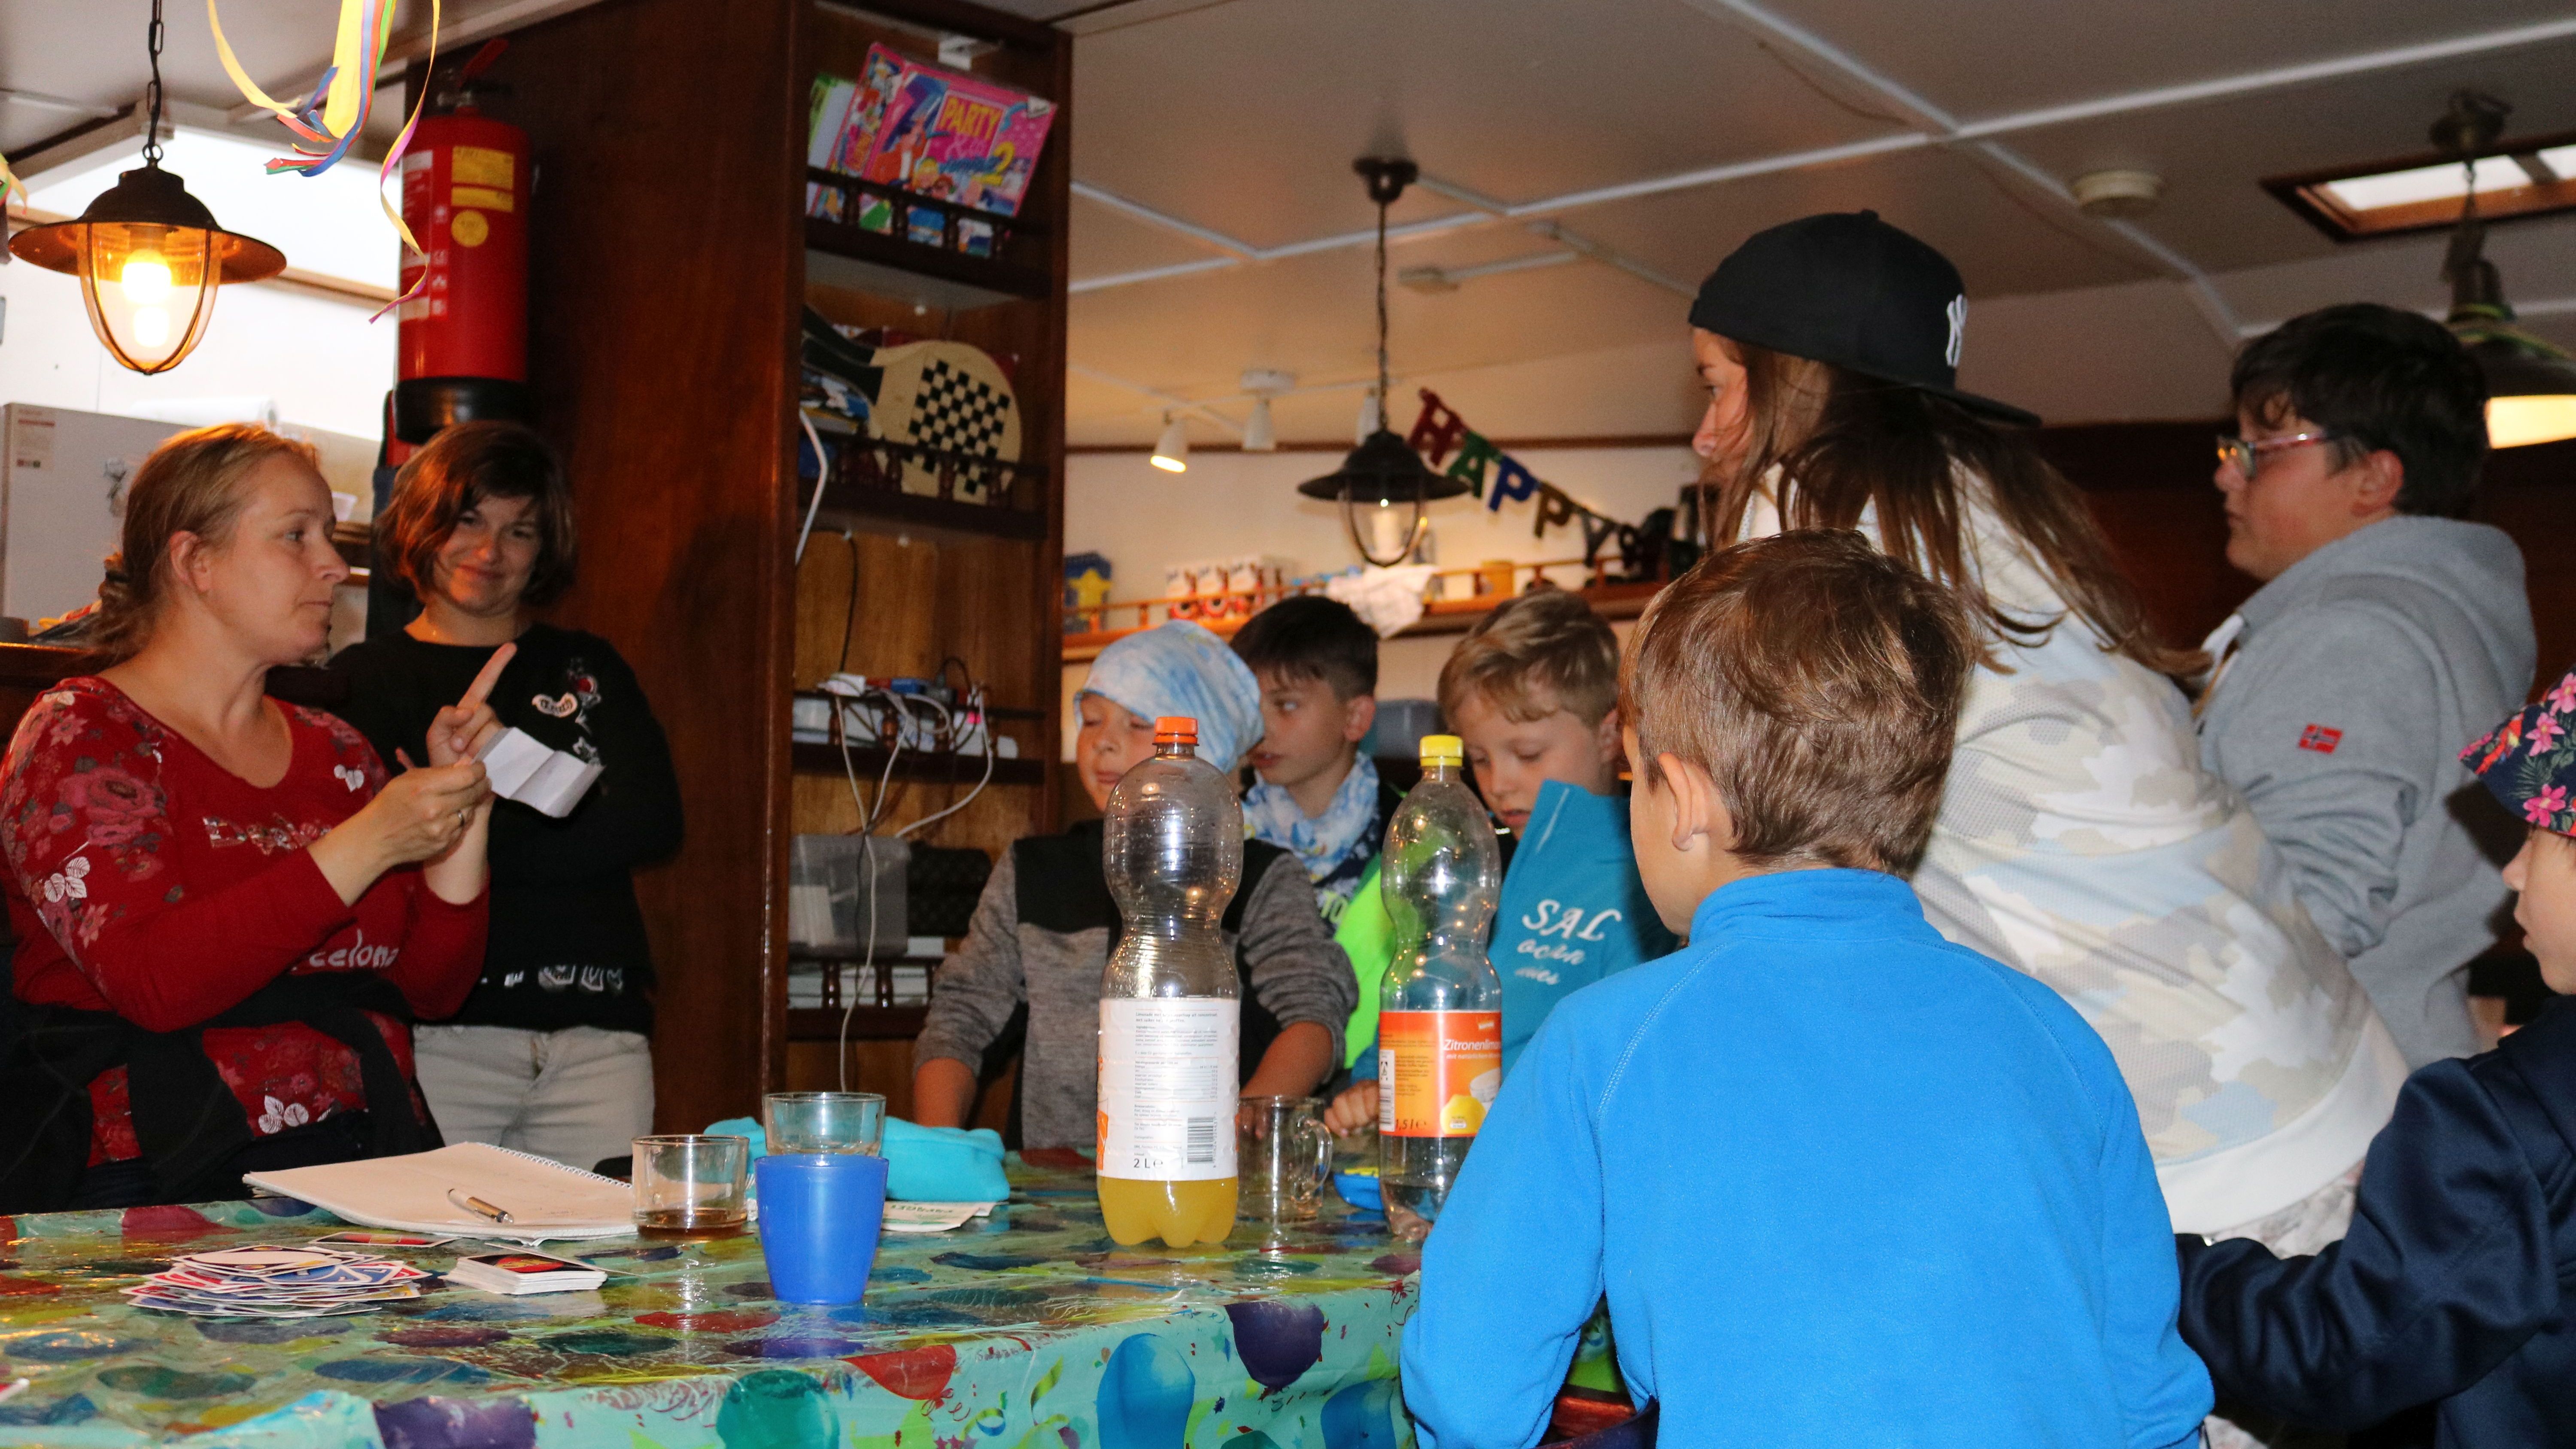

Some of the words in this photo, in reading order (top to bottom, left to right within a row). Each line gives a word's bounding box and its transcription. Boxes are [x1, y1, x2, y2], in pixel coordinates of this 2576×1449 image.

[937, 96, 1005, 140] PARTY
[971, 141, 1015, 186] 2
[1408, 386, 1620, 568] HAPPY
[1133, 1157, 1140, 1168] 2
[1144, 1157, 1151, 1169] L
